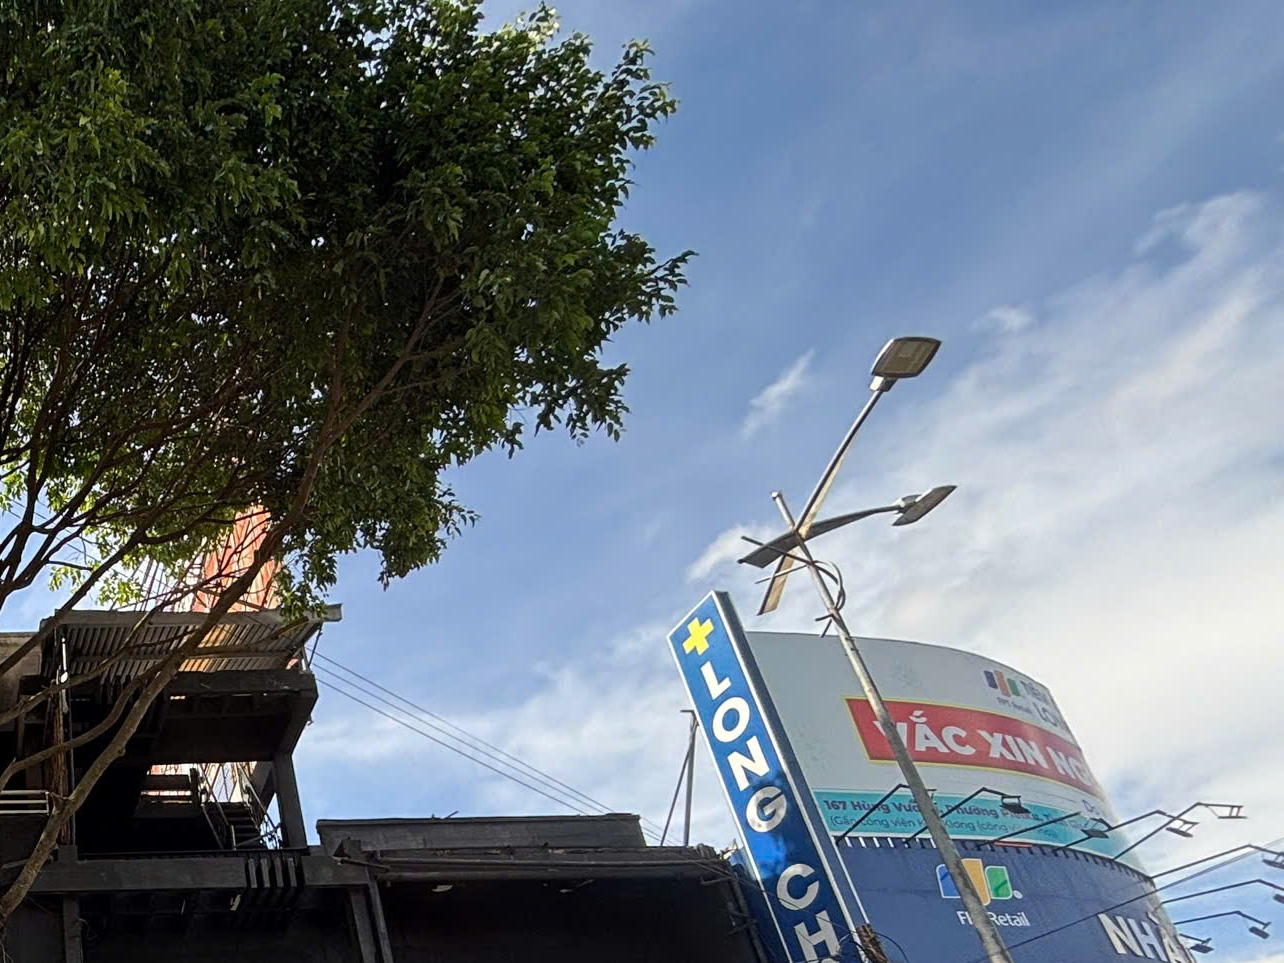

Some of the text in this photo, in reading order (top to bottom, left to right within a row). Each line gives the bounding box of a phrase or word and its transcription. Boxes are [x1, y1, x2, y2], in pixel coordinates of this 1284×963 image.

[700, 663, 788, 833] LONG
[977, 728, 1049, 769] XIN
[989, 911, 1031, 928] Retail
